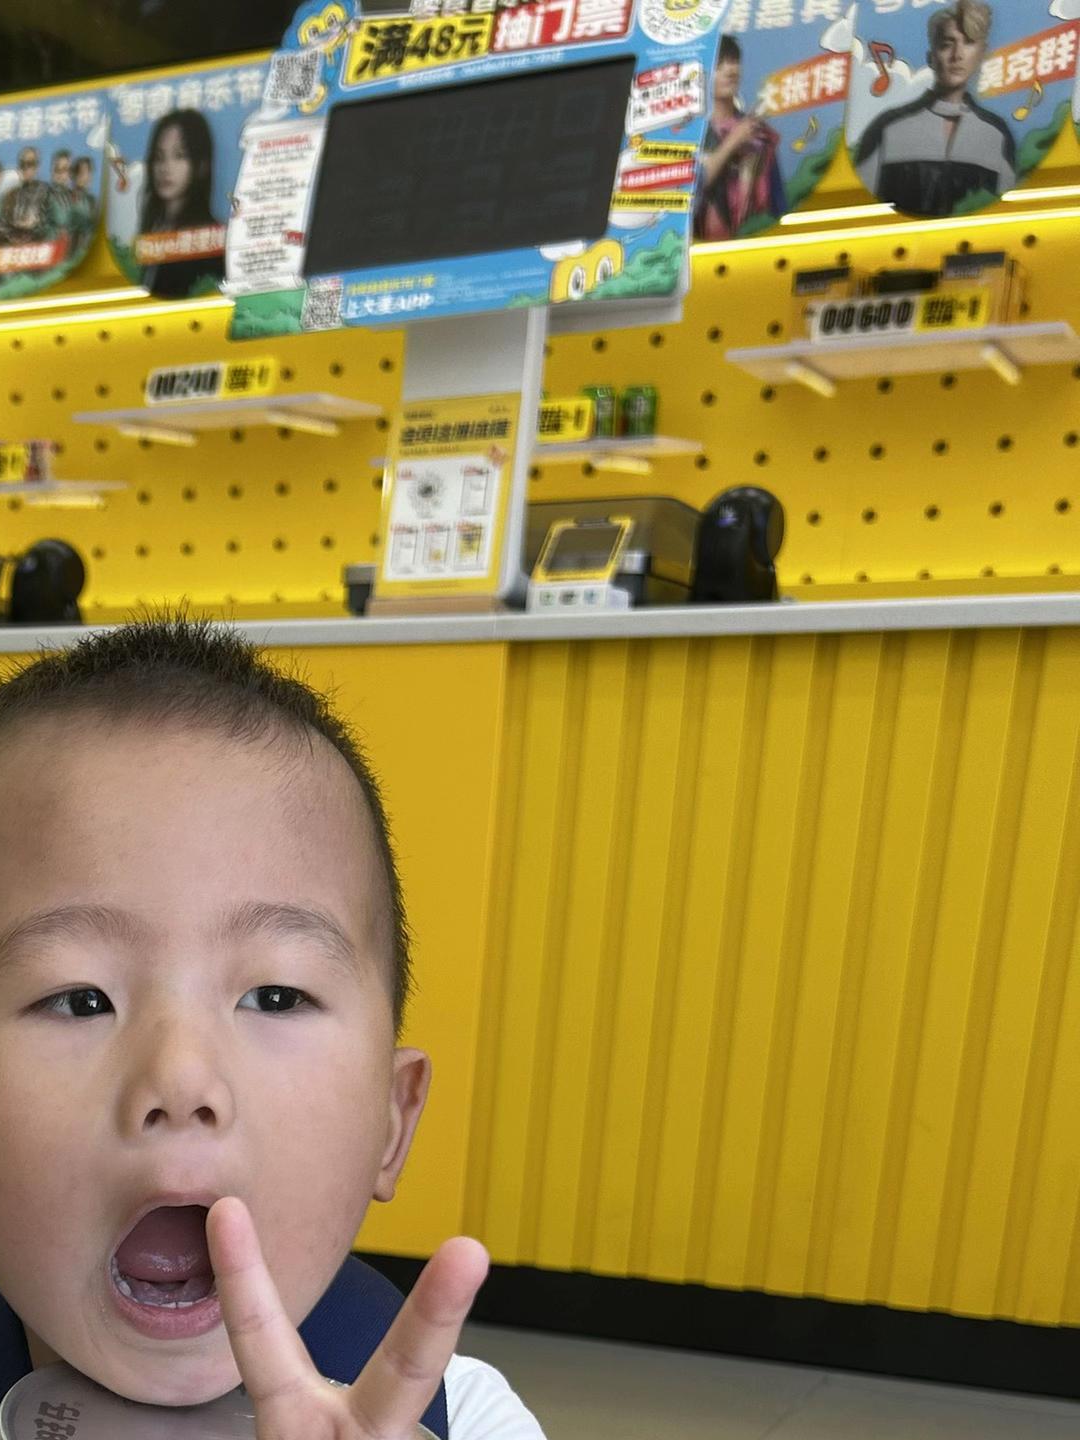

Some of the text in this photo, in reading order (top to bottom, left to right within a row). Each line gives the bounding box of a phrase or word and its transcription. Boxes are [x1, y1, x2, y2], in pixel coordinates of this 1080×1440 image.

[356, 17, 487, 76] 满48元
[493, 0, 628, 51] 抽门票
